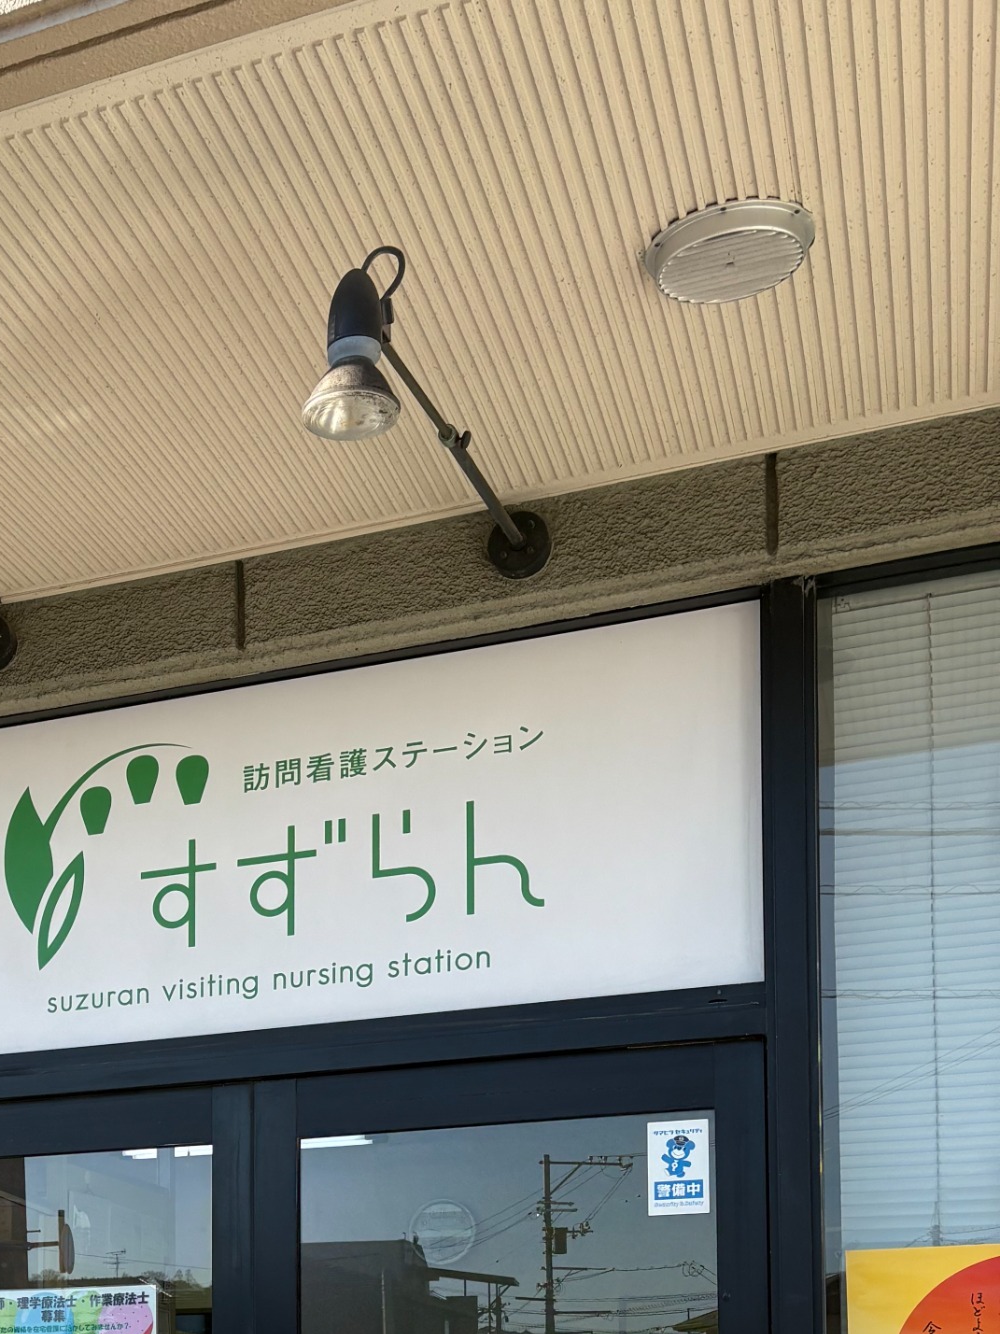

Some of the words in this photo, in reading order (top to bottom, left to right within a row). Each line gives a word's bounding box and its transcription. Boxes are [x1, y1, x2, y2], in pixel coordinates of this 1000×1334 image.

[242, 726, 544, 793] 訪問看護ステーション
[140, 800, 545, 947] すずらん
[47, 987, 149, 1013] suzuran
[162, 973, 259, 1000] visiting
[273, 962, 373, 989] nursing
[387, 949, 490, 979] station
[657, 1182, 700, 1197] 警備中
[41, 1310, 66, 1322] 募集
